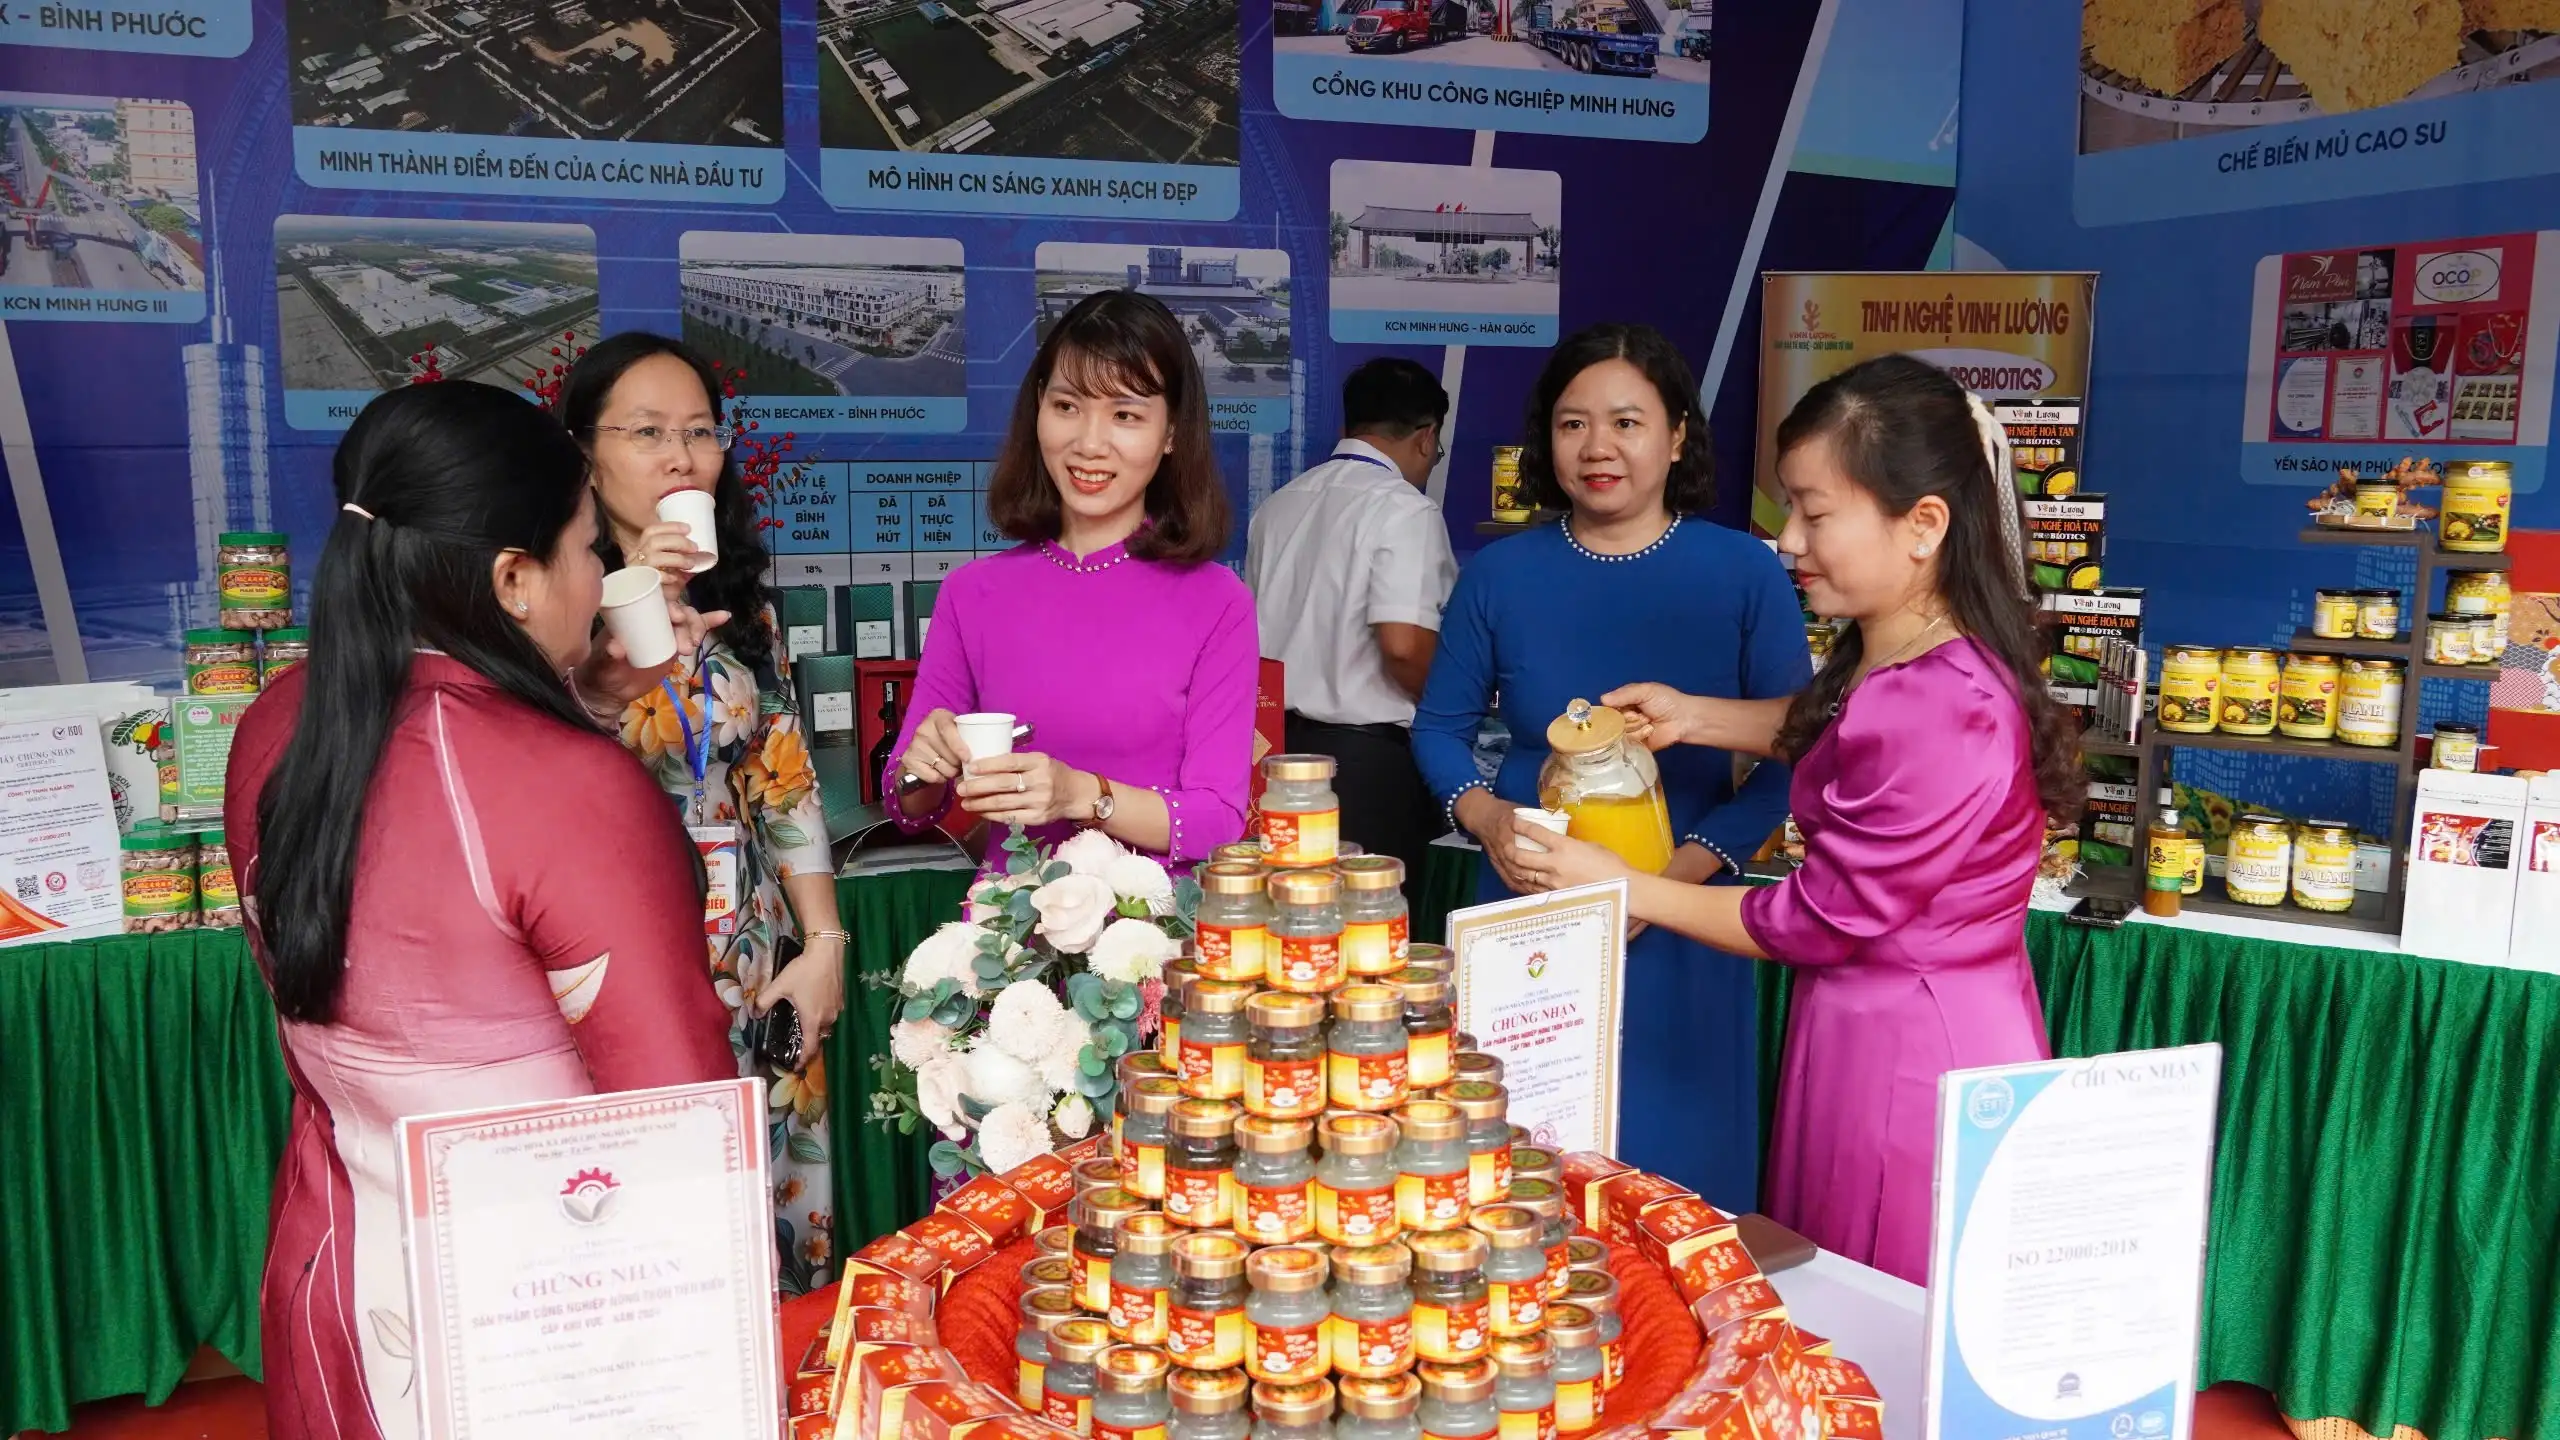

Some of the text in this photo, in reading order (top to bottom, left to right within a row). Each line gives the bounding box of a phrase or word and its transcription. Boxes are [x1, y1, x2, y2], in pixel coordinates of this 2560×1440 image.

[40, 2, 102, 32] BÌNH
[112, 10, 207, 38] PHƯỚC
[1312, 70, 1676, 118] CỔNG KHU CÔNG NGHIỆP MINH HƯNG
[2218, 120, 2447, 173] CHẾ BIẾN MỦ CAO SU
[320, 149, 763, 188] MINH THÀNH ĐIỂM ĐẾN CỦA CÁC NHÀ ĐẦU TƯ
[868, 167, 1197, 206] MÔ HÌNH CN SÁNG XANH SẠCH ĐẸP
[2432, 268, 2482, 287] OCOP
[4, 296, 168, 313] KCN MINH HƯNG III
[1861, 293, 2070, 343] TINH NGHỆ VINH LƯƠNG
[1385, 320, 1536, 335] KCN MINH HƯNG HÀN QUỐC
[328, 406, 358, 417] KHU
[743, 405, 926, 419] KCN BECAMEX BÌNH PHƯỚC
[1217, 402, 1257, 414] PHƯỚC
[2060, 426, 2074, 437] TAN
[2274, 454, 2298, 471] YẾN
[2301, 456, 2328, 472] SÀO
[2332, 459, 2362, 472] NAM
[2365, 458, 2394, 473] PHÚ
[812, 474, 826, 488] LỆ
[866, 471, 962, 488] DOANH NGHIỆP
[879, 496, 897, 508] ĐÃ
[928, 495, 946, 507] ĐÃ
[795, 511, 825, 523] BÌNH
[876, 515, 900, 525] THU
[920, 514, 954, 528] THỰC
[2083, 521, 2099, 532] TAN
[792, 529, 829, 541] QUÂN
[876, 530, 901, 543] HÚT
[924, 530, 952, 545] HIỆN
[805, 565, 822, 574] 18%
[880, 564, 891, 572] 75
[938, 563, 949, 572] 37
[2118, 617, 2136, 628] TAN
[1491, 1003, 1578, 1033] CHỨNG NHẬN
[2007, 1236, 2140, 1270] ISO 22000:2018
[512, 1256, 683, 1300] CHỨNG NHẬN
